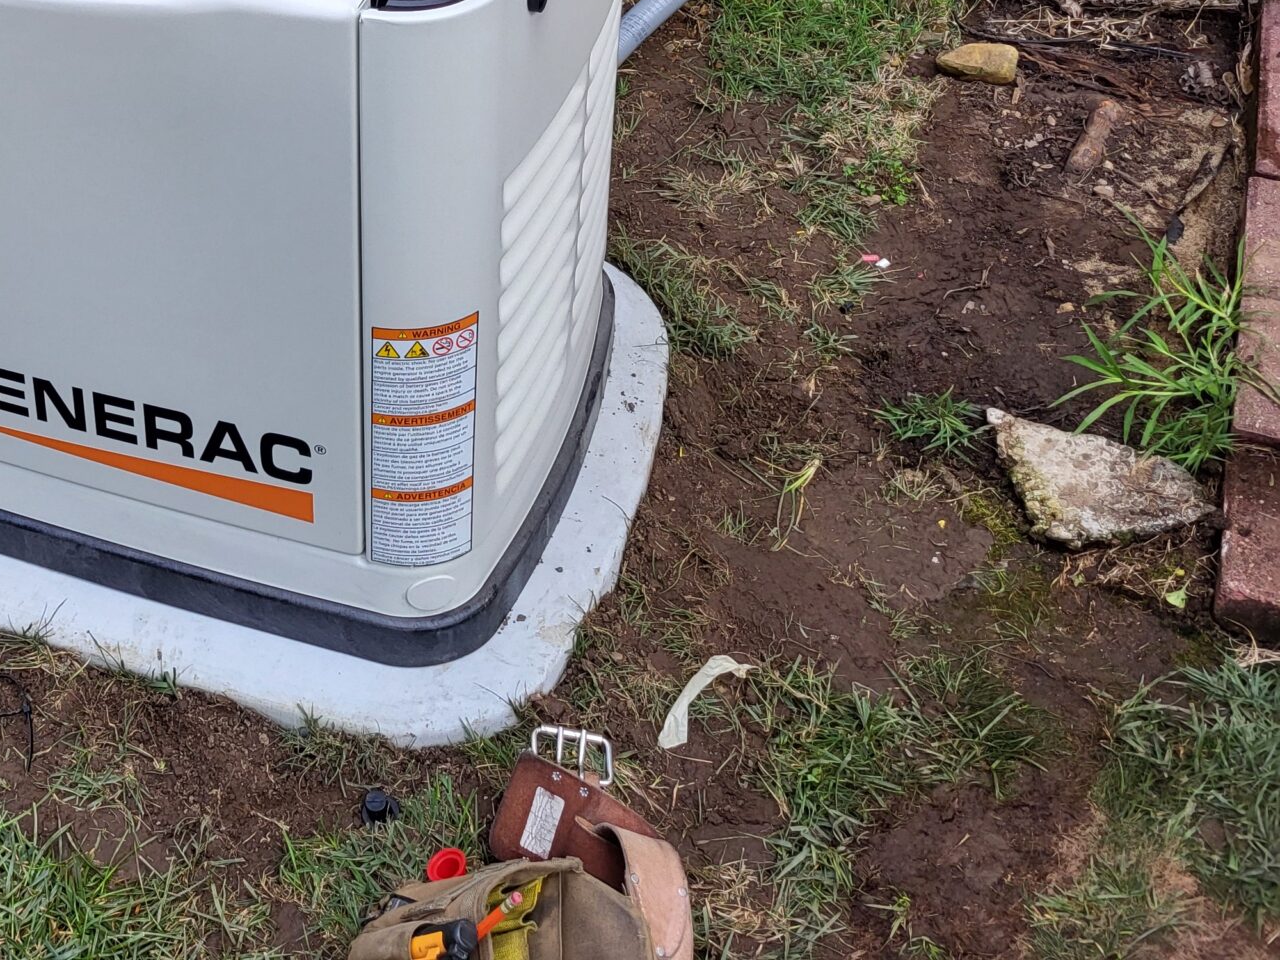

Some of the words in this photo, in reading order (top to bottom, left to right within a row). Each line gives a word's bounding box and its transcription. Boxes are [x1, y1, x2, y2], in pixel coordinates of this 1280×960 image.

[412, 323, 460, 338] WARNING
[390, 404, 471, 424] AVERTISSEMENT
[396, 483, 465, 500] ADVERTENCIA
